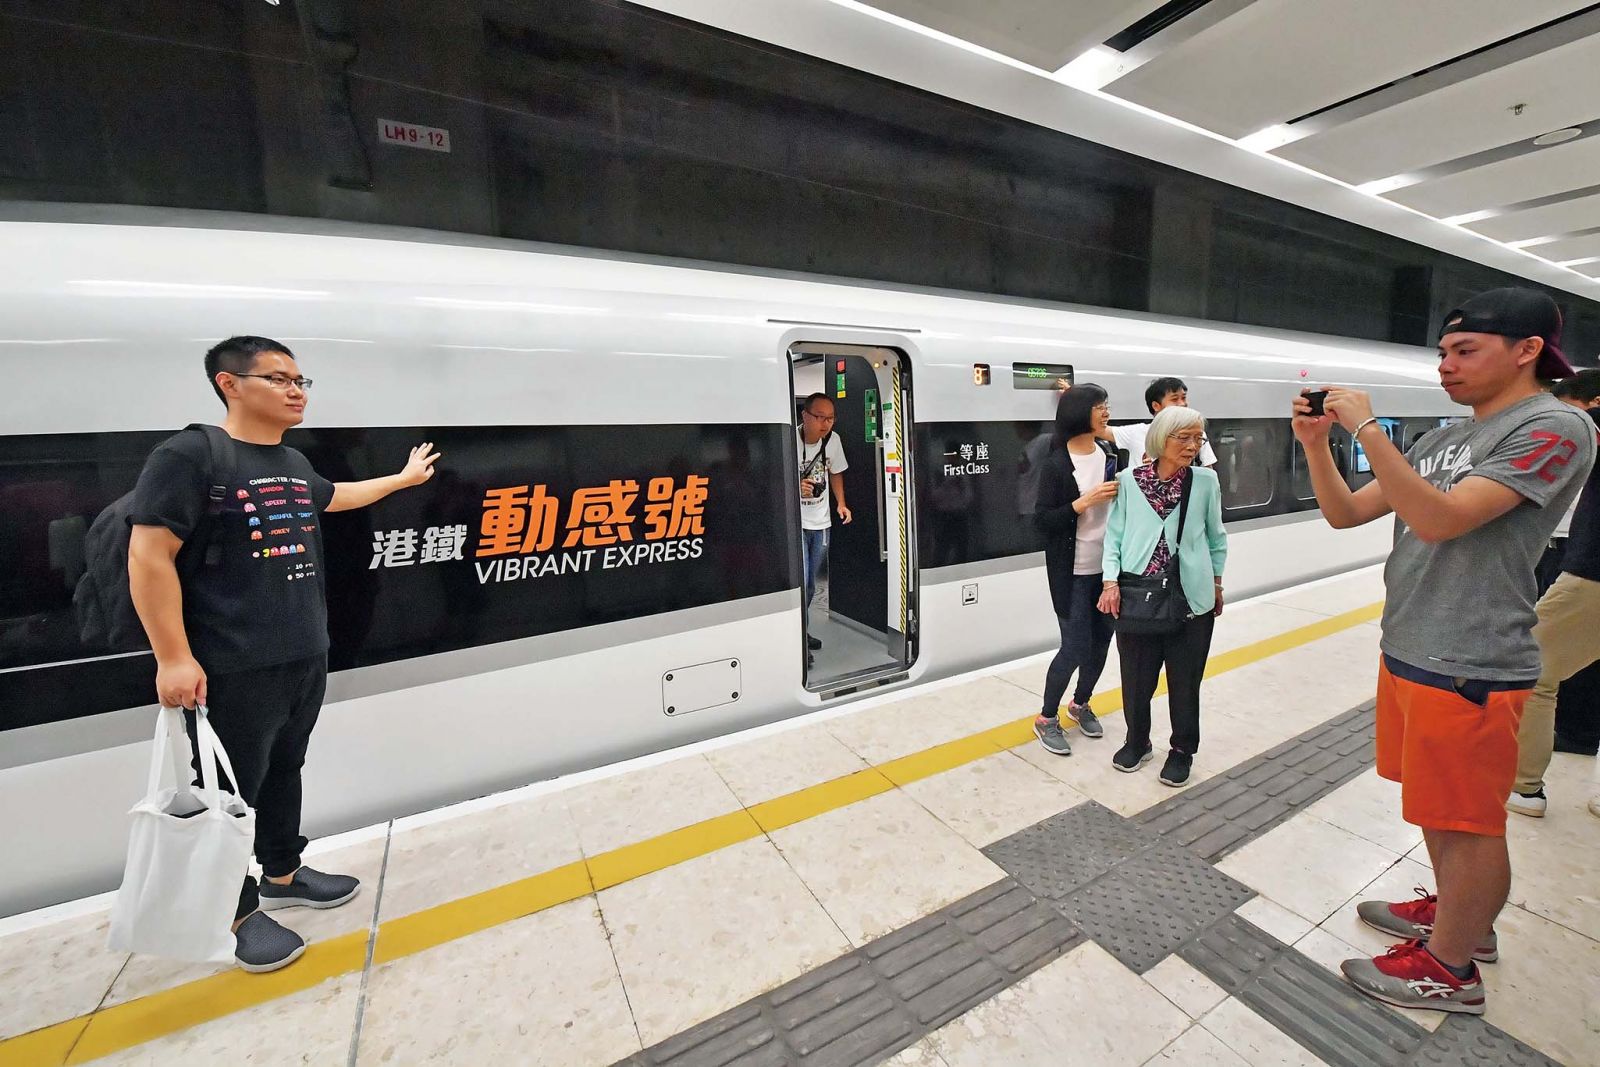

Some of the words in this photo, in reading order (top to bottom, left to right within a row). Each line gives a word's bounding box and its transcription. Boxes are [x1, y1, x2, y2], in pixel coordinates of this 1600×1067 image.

[974, 366, 983, 385] 8
[943, 442, 990, 461] 一等座
[1508, 427, 1578, 484] 72
[943, 464, 965, 477] First
[966, 462, 990, 475] Class
[368, 524, 468, 570] 港鐵
[475, 474, 710, 558] 動感號
[474, 550, 597, 585] VIBRANT
[602, 537, 704, 570] EXPRESS
